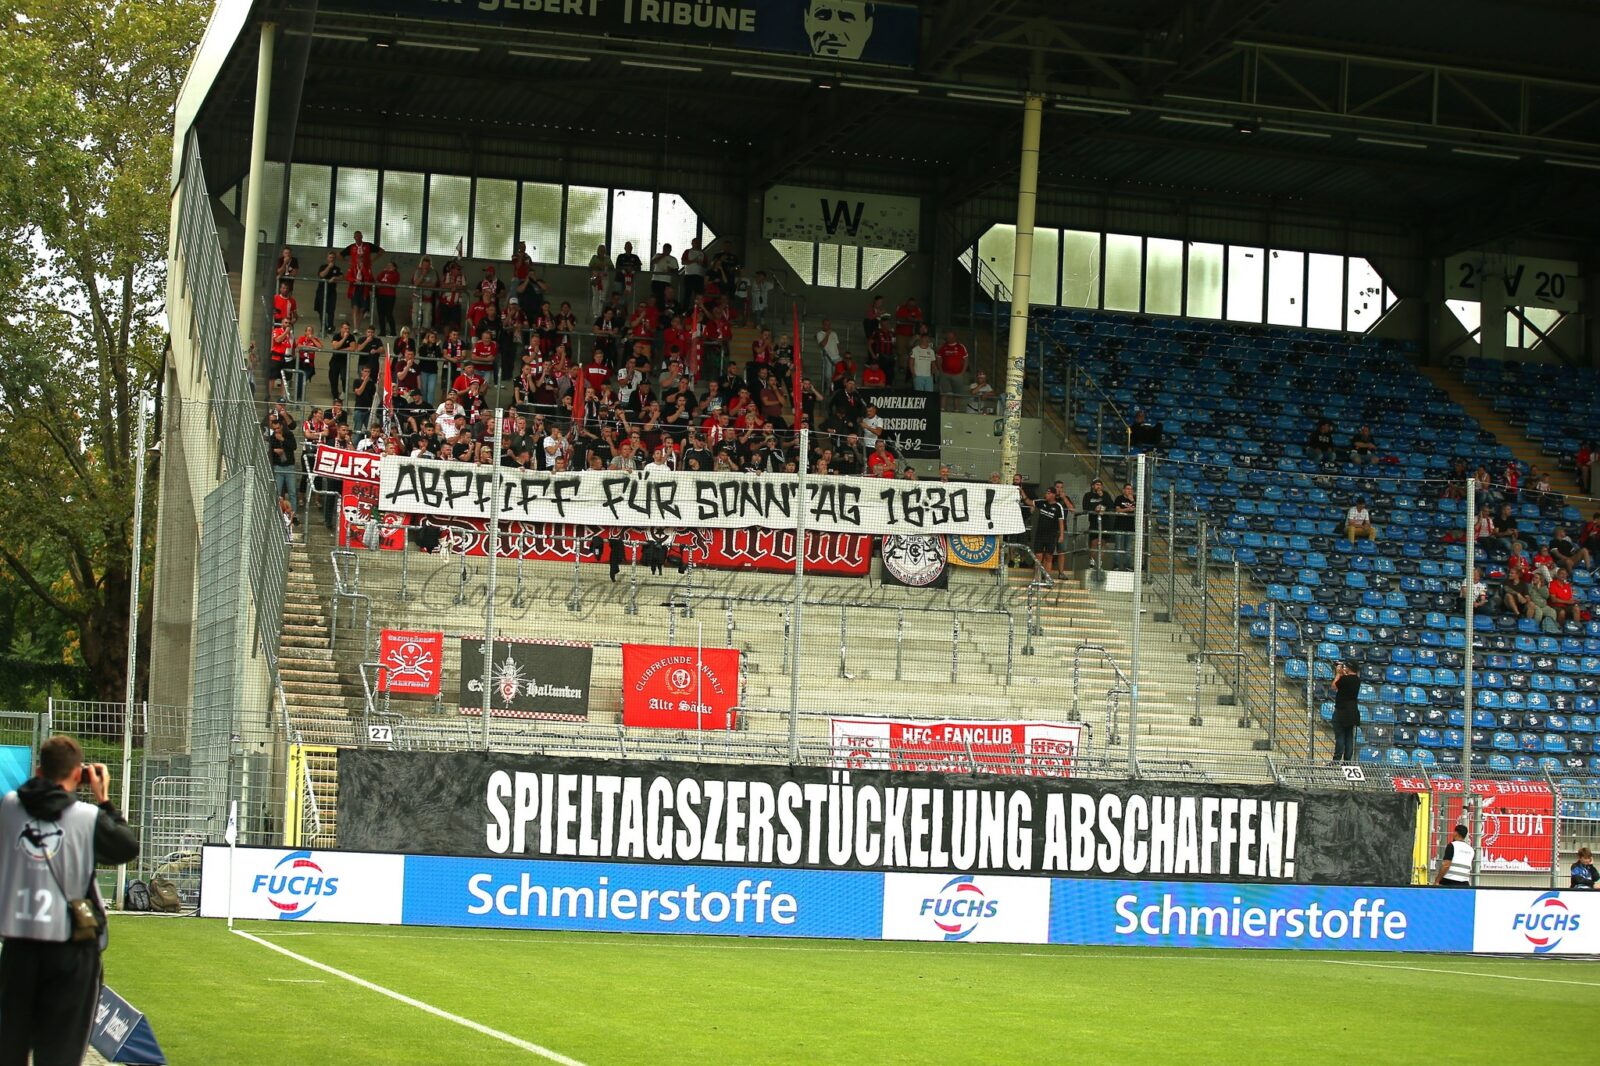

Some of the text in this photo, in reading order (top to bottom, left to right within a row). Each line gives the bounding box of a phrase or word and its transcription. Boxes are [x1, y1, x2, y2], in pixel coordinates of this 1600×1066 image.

[820, 198, 864, 237] W
[1535, 271, 1566, 298] 20
[870, 396, 927, 409] DOMFALKEN
[386, 464, 996, 529] ABPFIFF FÜR SONNTAG 16:30 !
[635, 655, 693, 692] CLUBFREUNDE
[649, 697, 674, 711] Alte
[371, 727, 390, 740] 27
[902, 728, 932, 743] HFC
[944, 727, 1013, 745] FANCLUB
[1033, 740, 1069, 754] HFC
[1344, 767, 1362, 780] 26
[486, 769, 1300, 878] SPIELTAGSZERSTÜCKELUNG ABSCHAFFEN!
[1509, 814, 1544, 836] LUJA
[252, 874, 339, 896] FUCHS
[15, 888, 52, 923] 12
[467, 873, 798, 925] Schmierstoffe
[919, 898, 998, 917] FUCHS
[1115, 894, 1408, 939] Schmierstoffe
[1512, 913, 1581, 931] FUCHS
